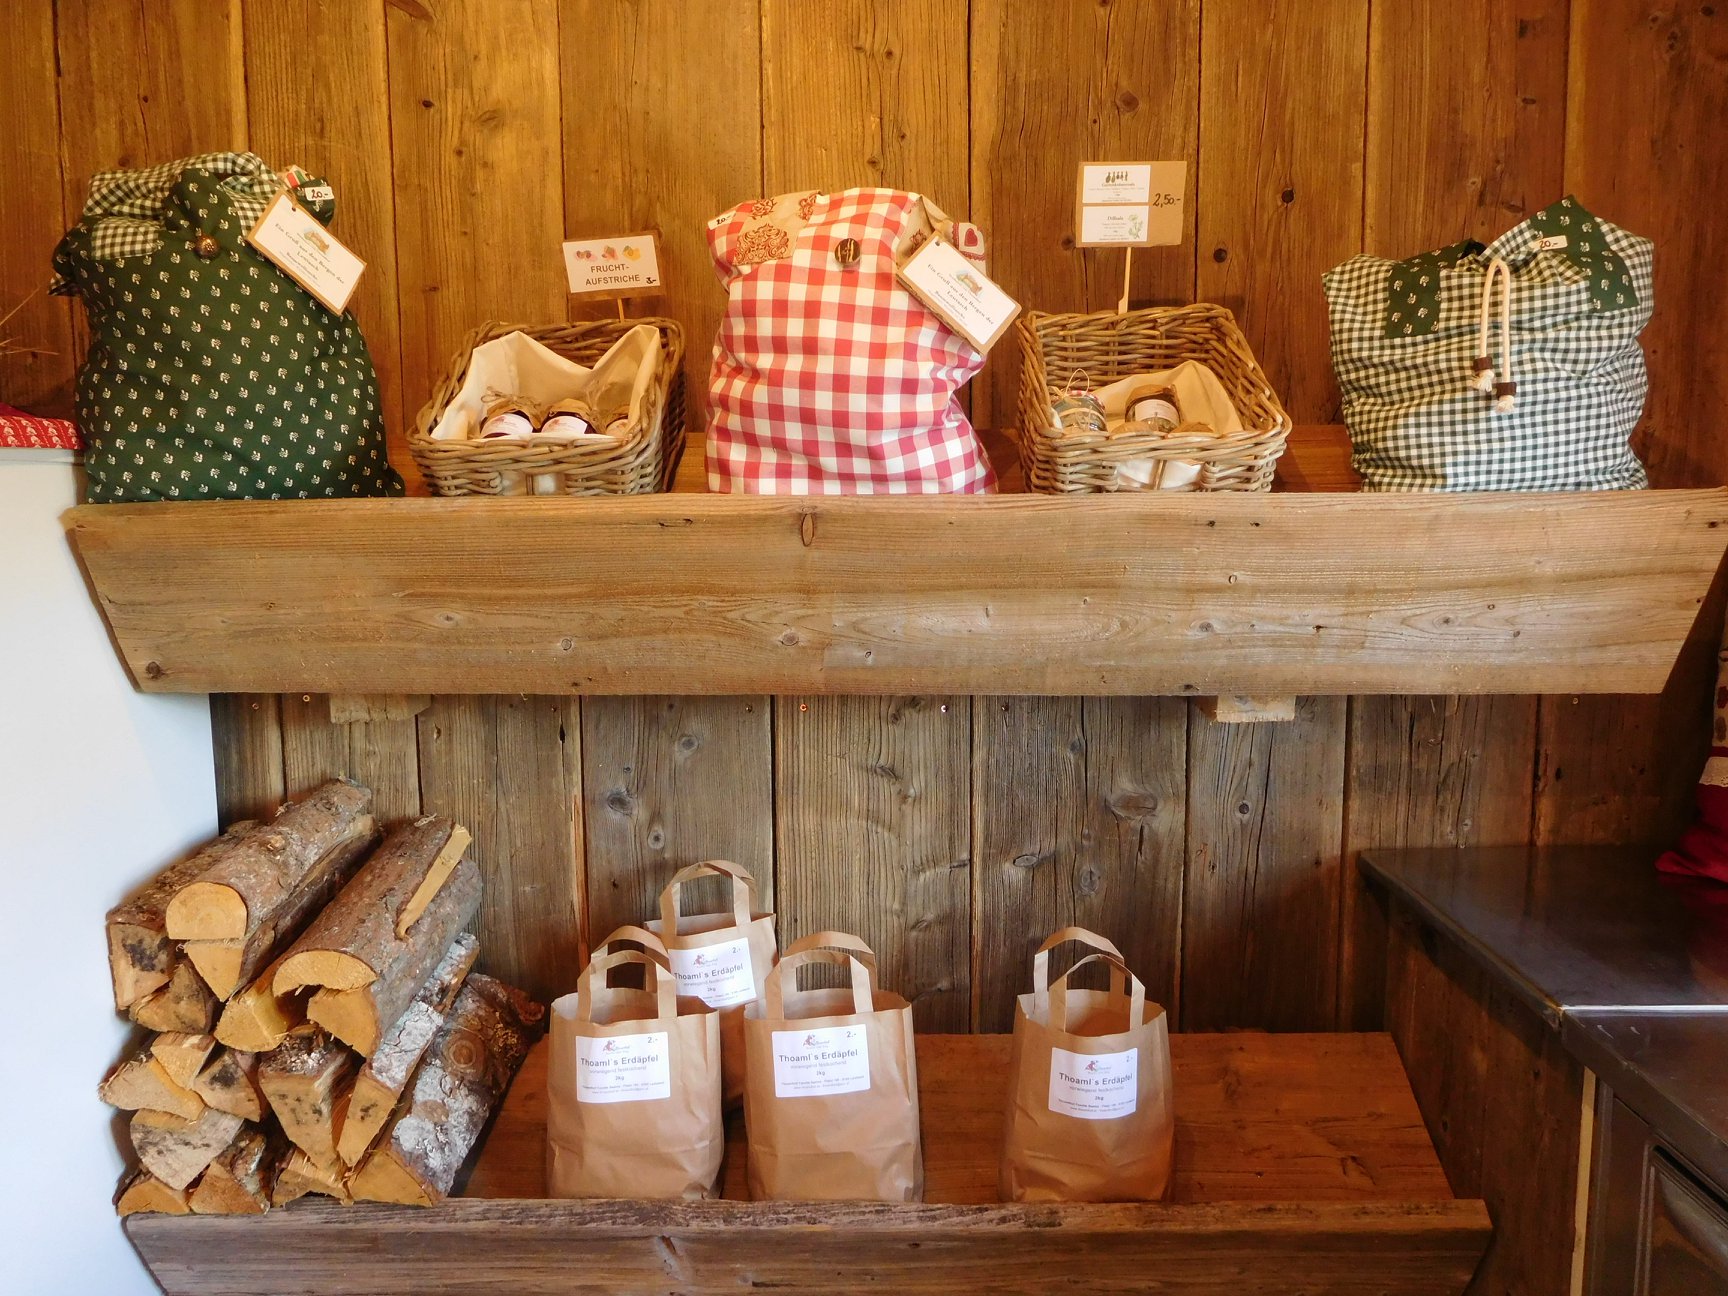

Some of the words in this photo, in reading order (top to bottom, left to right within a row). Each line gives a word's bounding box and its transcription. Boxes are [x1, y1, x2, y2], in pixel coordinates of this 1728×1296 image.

[590, 263, 630, 273] FRUCHT-
[585, 274, 640, 286] AUFSTRICHE
[711, 963, 743, 977] Erdäpfel
[621, 1054, 658, 1065] Erdäpfel
[821, 1049, 858, 1060] Erdäpfel
[1102, 1073, 1133, 1085] Erdäpfel
